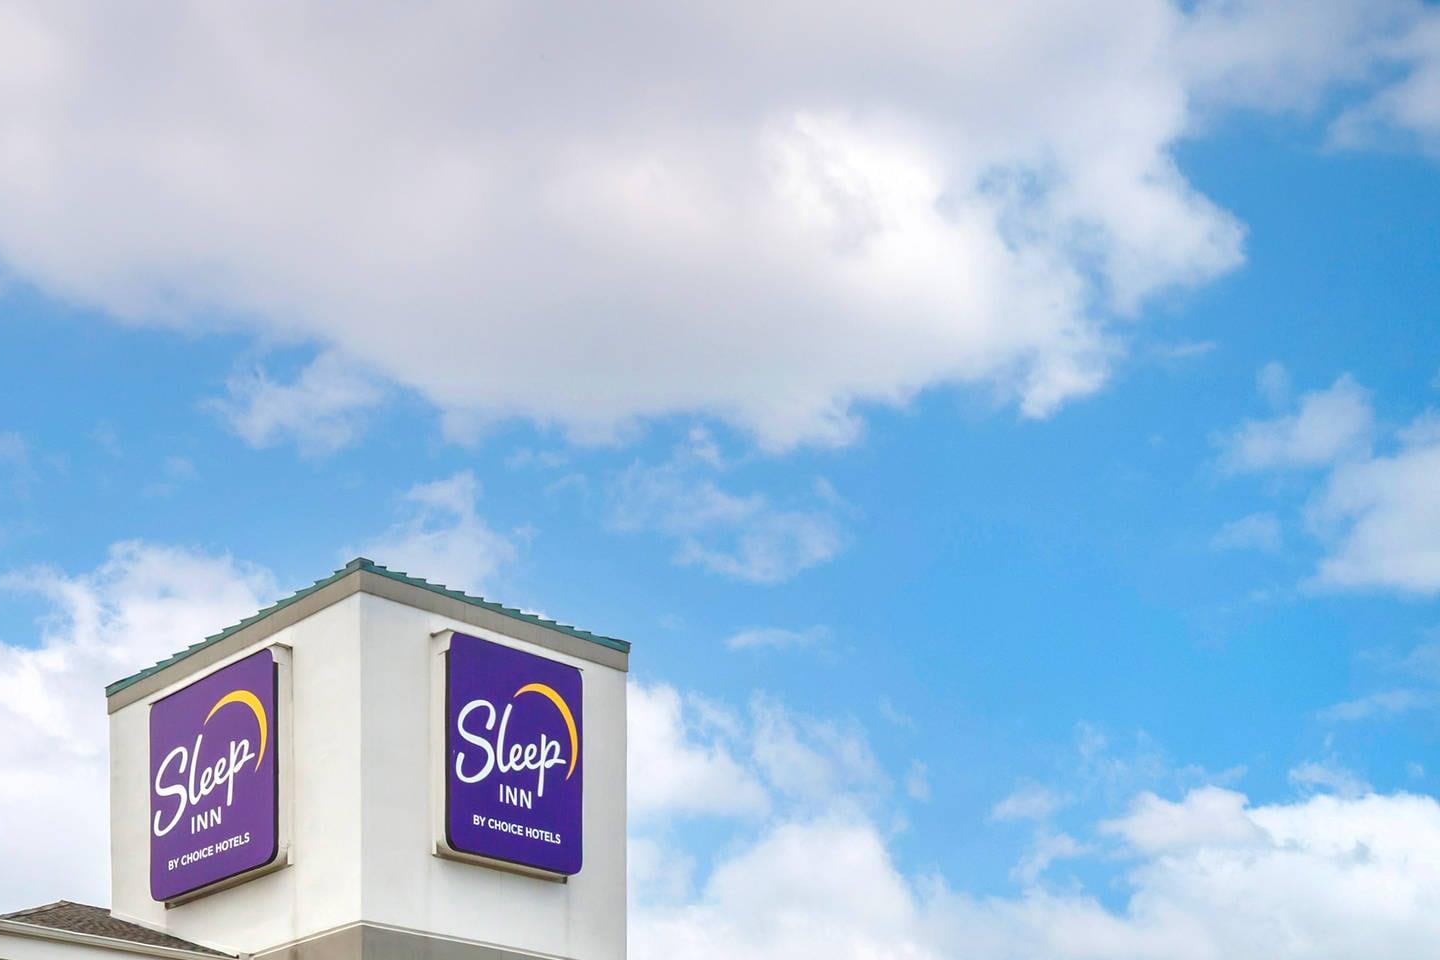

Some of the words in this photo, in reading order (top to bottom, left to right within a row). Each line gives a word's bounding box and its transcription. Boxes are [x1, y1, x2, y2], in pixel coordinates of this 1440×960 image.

[455, 698, 566, 797] Sleep
[153, 733, 255, 837] Sleep
[499, 783, 532, 809] INN
[191, 806, 222, 835] INN
[472, 814, 486, 827] BY
[487, 818, 524, 836] CHOICE
[525, 826, 561, 845] HOTELS
[168, 857, 180, 871] BY
[180, 845, 214, 866] CHOICE
[215, 832, 250, 854] HOTELS
